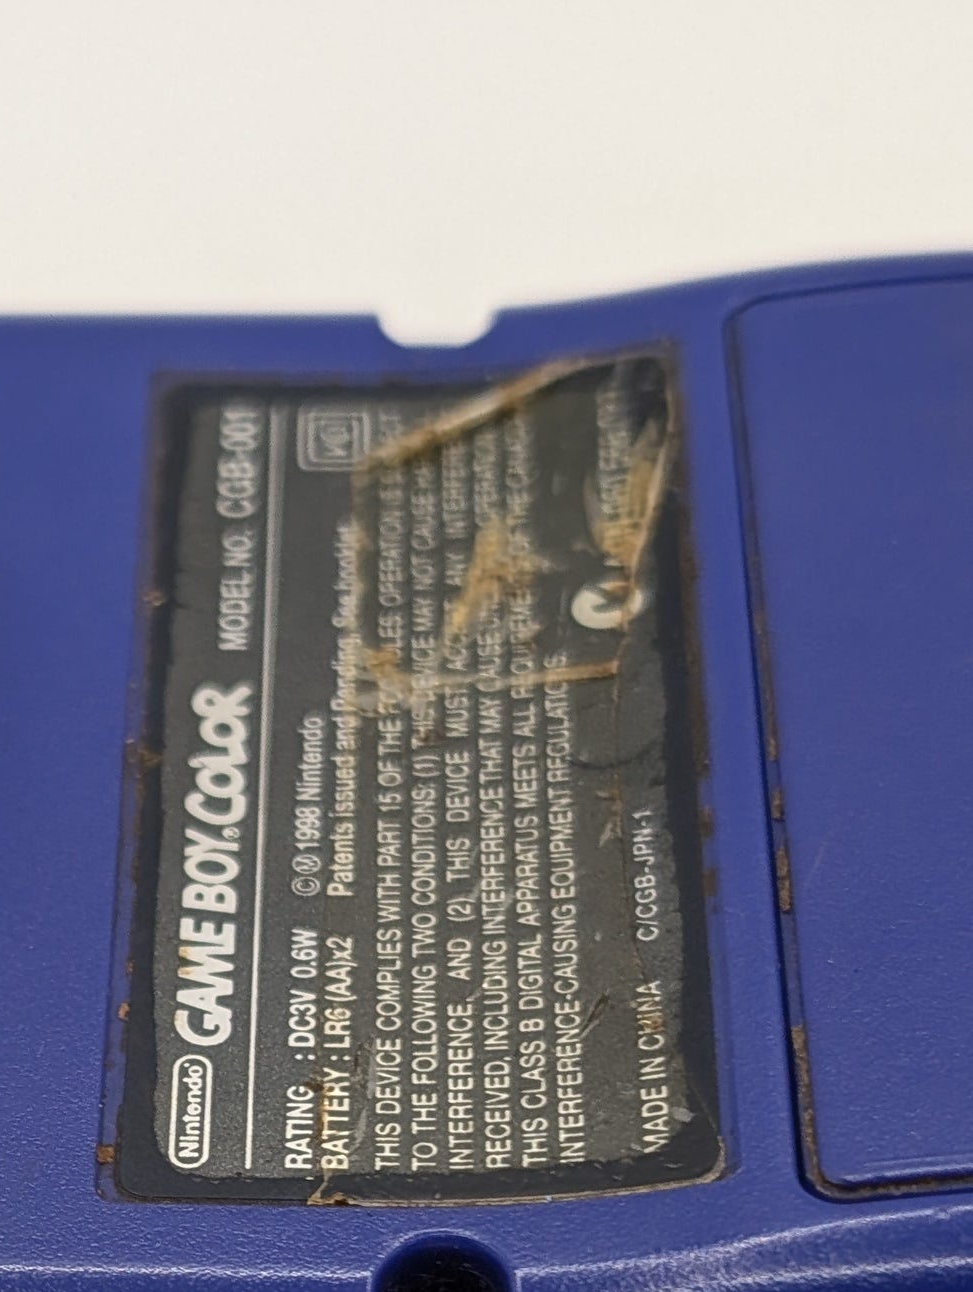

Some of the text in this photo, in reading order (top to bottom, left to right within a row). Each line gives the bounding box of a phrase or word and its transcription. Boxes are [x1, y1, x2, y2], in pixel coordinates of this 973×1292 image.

[216, 408, 259, 650] MODEL NO. CGB-001
[443, 598, 468, 670] ACCT
[331, 716, 356, 749] and
[378, 718, 402, 756] THE
[411, 708, 435, 748] THIS
[444, 685, 470, 736] MUST
[478, 696, 502, 733] MAY
[511, 702, 536, 736] ALL
[296, 716, 324, 800] Nintendo
[328, 755, 354, 817] issued
[378, 761, 402, 786] OF
[410, 755, 438, 776] (1)
[445, 750, 470, 821] DEVICE
[478, 738, 504, 782] THAT
[512, 742, 539, 807] MEETS
[294, 806, 322, 849] 1998
[377, 793, 402, 811] 15
[181, 828, 240, 914] BOY
[327, 822, 354, 896] Patents
[378, 819, 402, 866] PART
[445, 837, 470, 882] THIS
[478, 786, 506, 934] INTERFERENCE
[514, 814, 542, 925] APPARATUS
[377, 874, 401, 922] WITH
[631, 808, 660, 942] C/CGB-JPN-1
[411, 912, 437, 957] TWO
[446, 897, 475, 921] (2)
[543, 652, 586, 1162] INTERFERENCE-CAUSING EQUIPMENT REGULATIOS.
[174, 917, 235, 1046] GAME
[291, 928, 317, 978] 0.6W
[324, 936, 357, 1001] (AA)x2
[376, 928, 402, 1030] COMPLIES
[446, 938, 472, 980] AND
[517, 934, 544, 1009] DIGITAL
[289, 989, 316, 1047] DC3V
[412, 964, 438, 1083] FOLLOWING
[482, 940, 510, 1050] INCLUDING
[519, 1018, 545, 1031] B
[324, 1007, 352, 1048] LR6
[376, 1038, 401, 1113] DEVICE
[447, 997, 474, 1169] INTERFERENCE,
[519, 1040, 547, 1108] CLASS
[638, 1056, 666, 1080] IN
[178, 1062, 204, 1158] Nintendo
[285, 1085, 314, 1169] RATING
[321, 1066, 350, 1169] BATTERY
[412, 1093, 437, 1134] THE
[484, 1056, 512, 1168] RECEIVED,
[639, 1085, 670, 1152] MADE
[376, 1122, 401, 1169] THIS
[412, 1142, 437, 1170] TO
[521, 1116, 549, 1167] THIS
